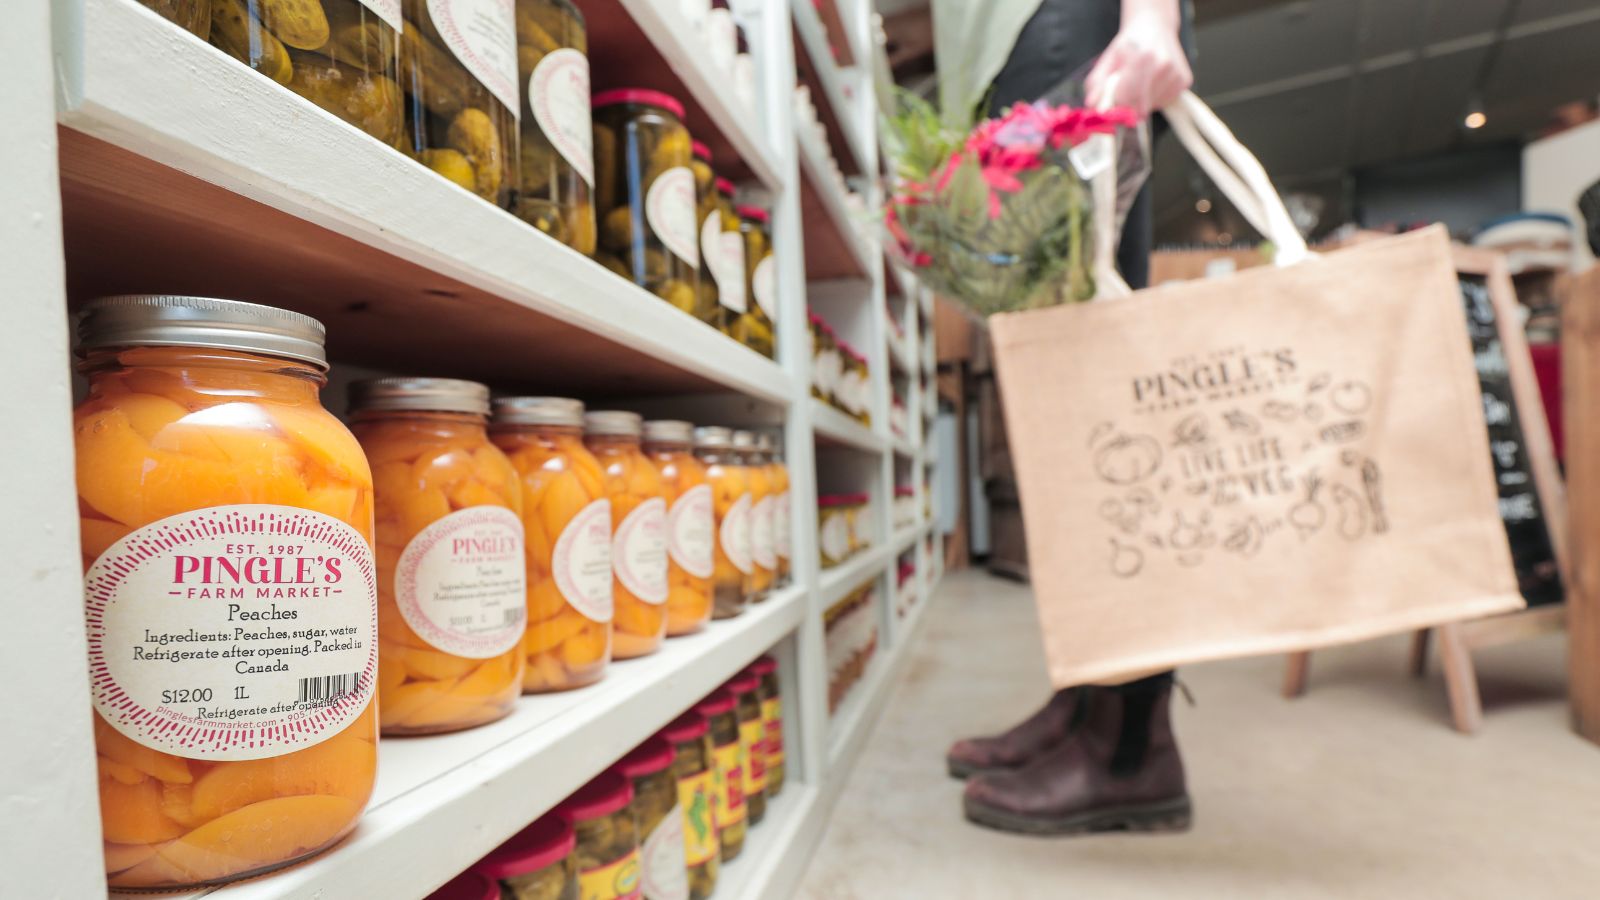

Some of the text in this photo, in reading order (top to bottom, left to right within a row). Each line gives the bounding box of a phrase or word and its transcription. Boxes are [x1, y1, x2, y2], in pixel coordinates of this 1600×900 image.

[227, 544, 304, 555] EST. 1987
[172, 555, 342, 585] PINGLE'S
[187, 586, 331, 599] FARM MARKET
[227, 603, 298, 621] Peaches
[144, 625, 358, 645] Ingredients: Peaches, sugar, water
[132, 638, 362, 663] Refrigerate after opening. Packed in
[235, 659, 289, 674] Canada
[161, 686, 250, 705] $12.00 1L
[156, 706, 277, 729] pinglesfarmmarket.com
[197, 706, 268, 719] Refrigerate
[269, 702, 296, 714] after
